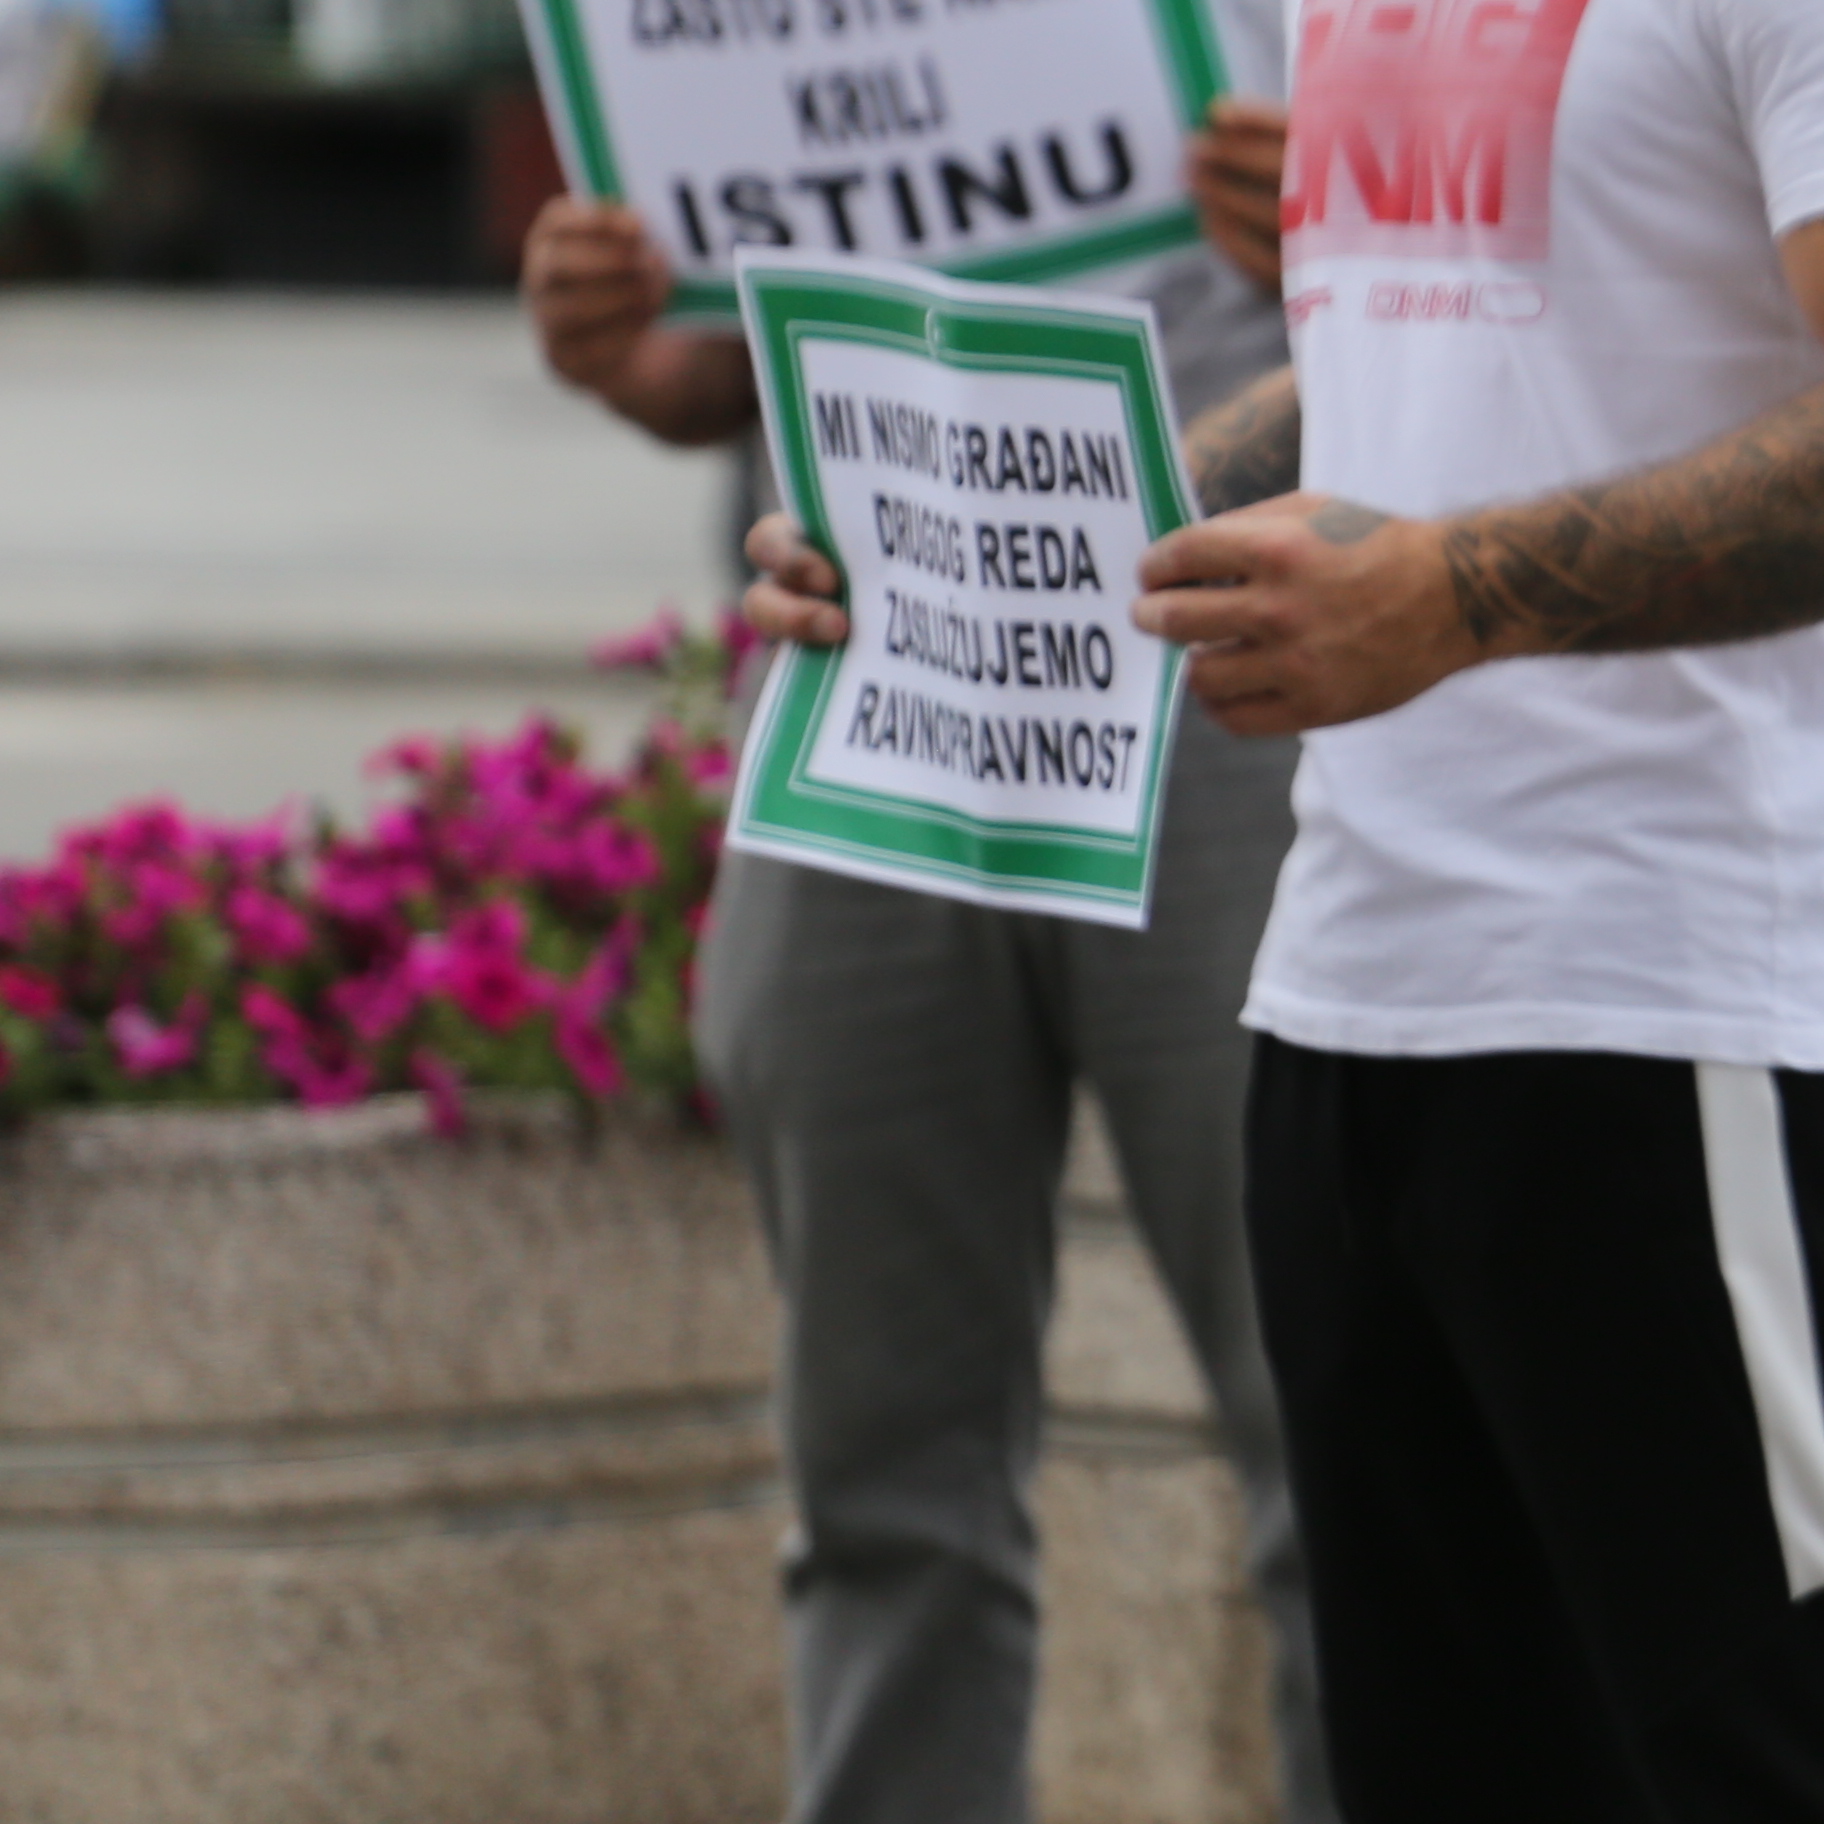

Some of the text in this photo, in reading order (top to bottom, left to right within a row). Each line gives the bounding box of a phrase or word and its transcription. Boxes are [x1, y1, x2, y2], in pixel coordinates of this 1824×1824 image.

[787, 58, 947, 146] KRILI
[674, 123, 1137, 260] ISTINU
[814, 393, 1128, 500] MI NISMO GRAĐANI
[873, 492, 1102, 593] DRUGOG REDA
[886, 590, 1114, 691] ZASLUŽUJEMO
[849, 684, 1137, 791] RAVNOPRAVNOST
